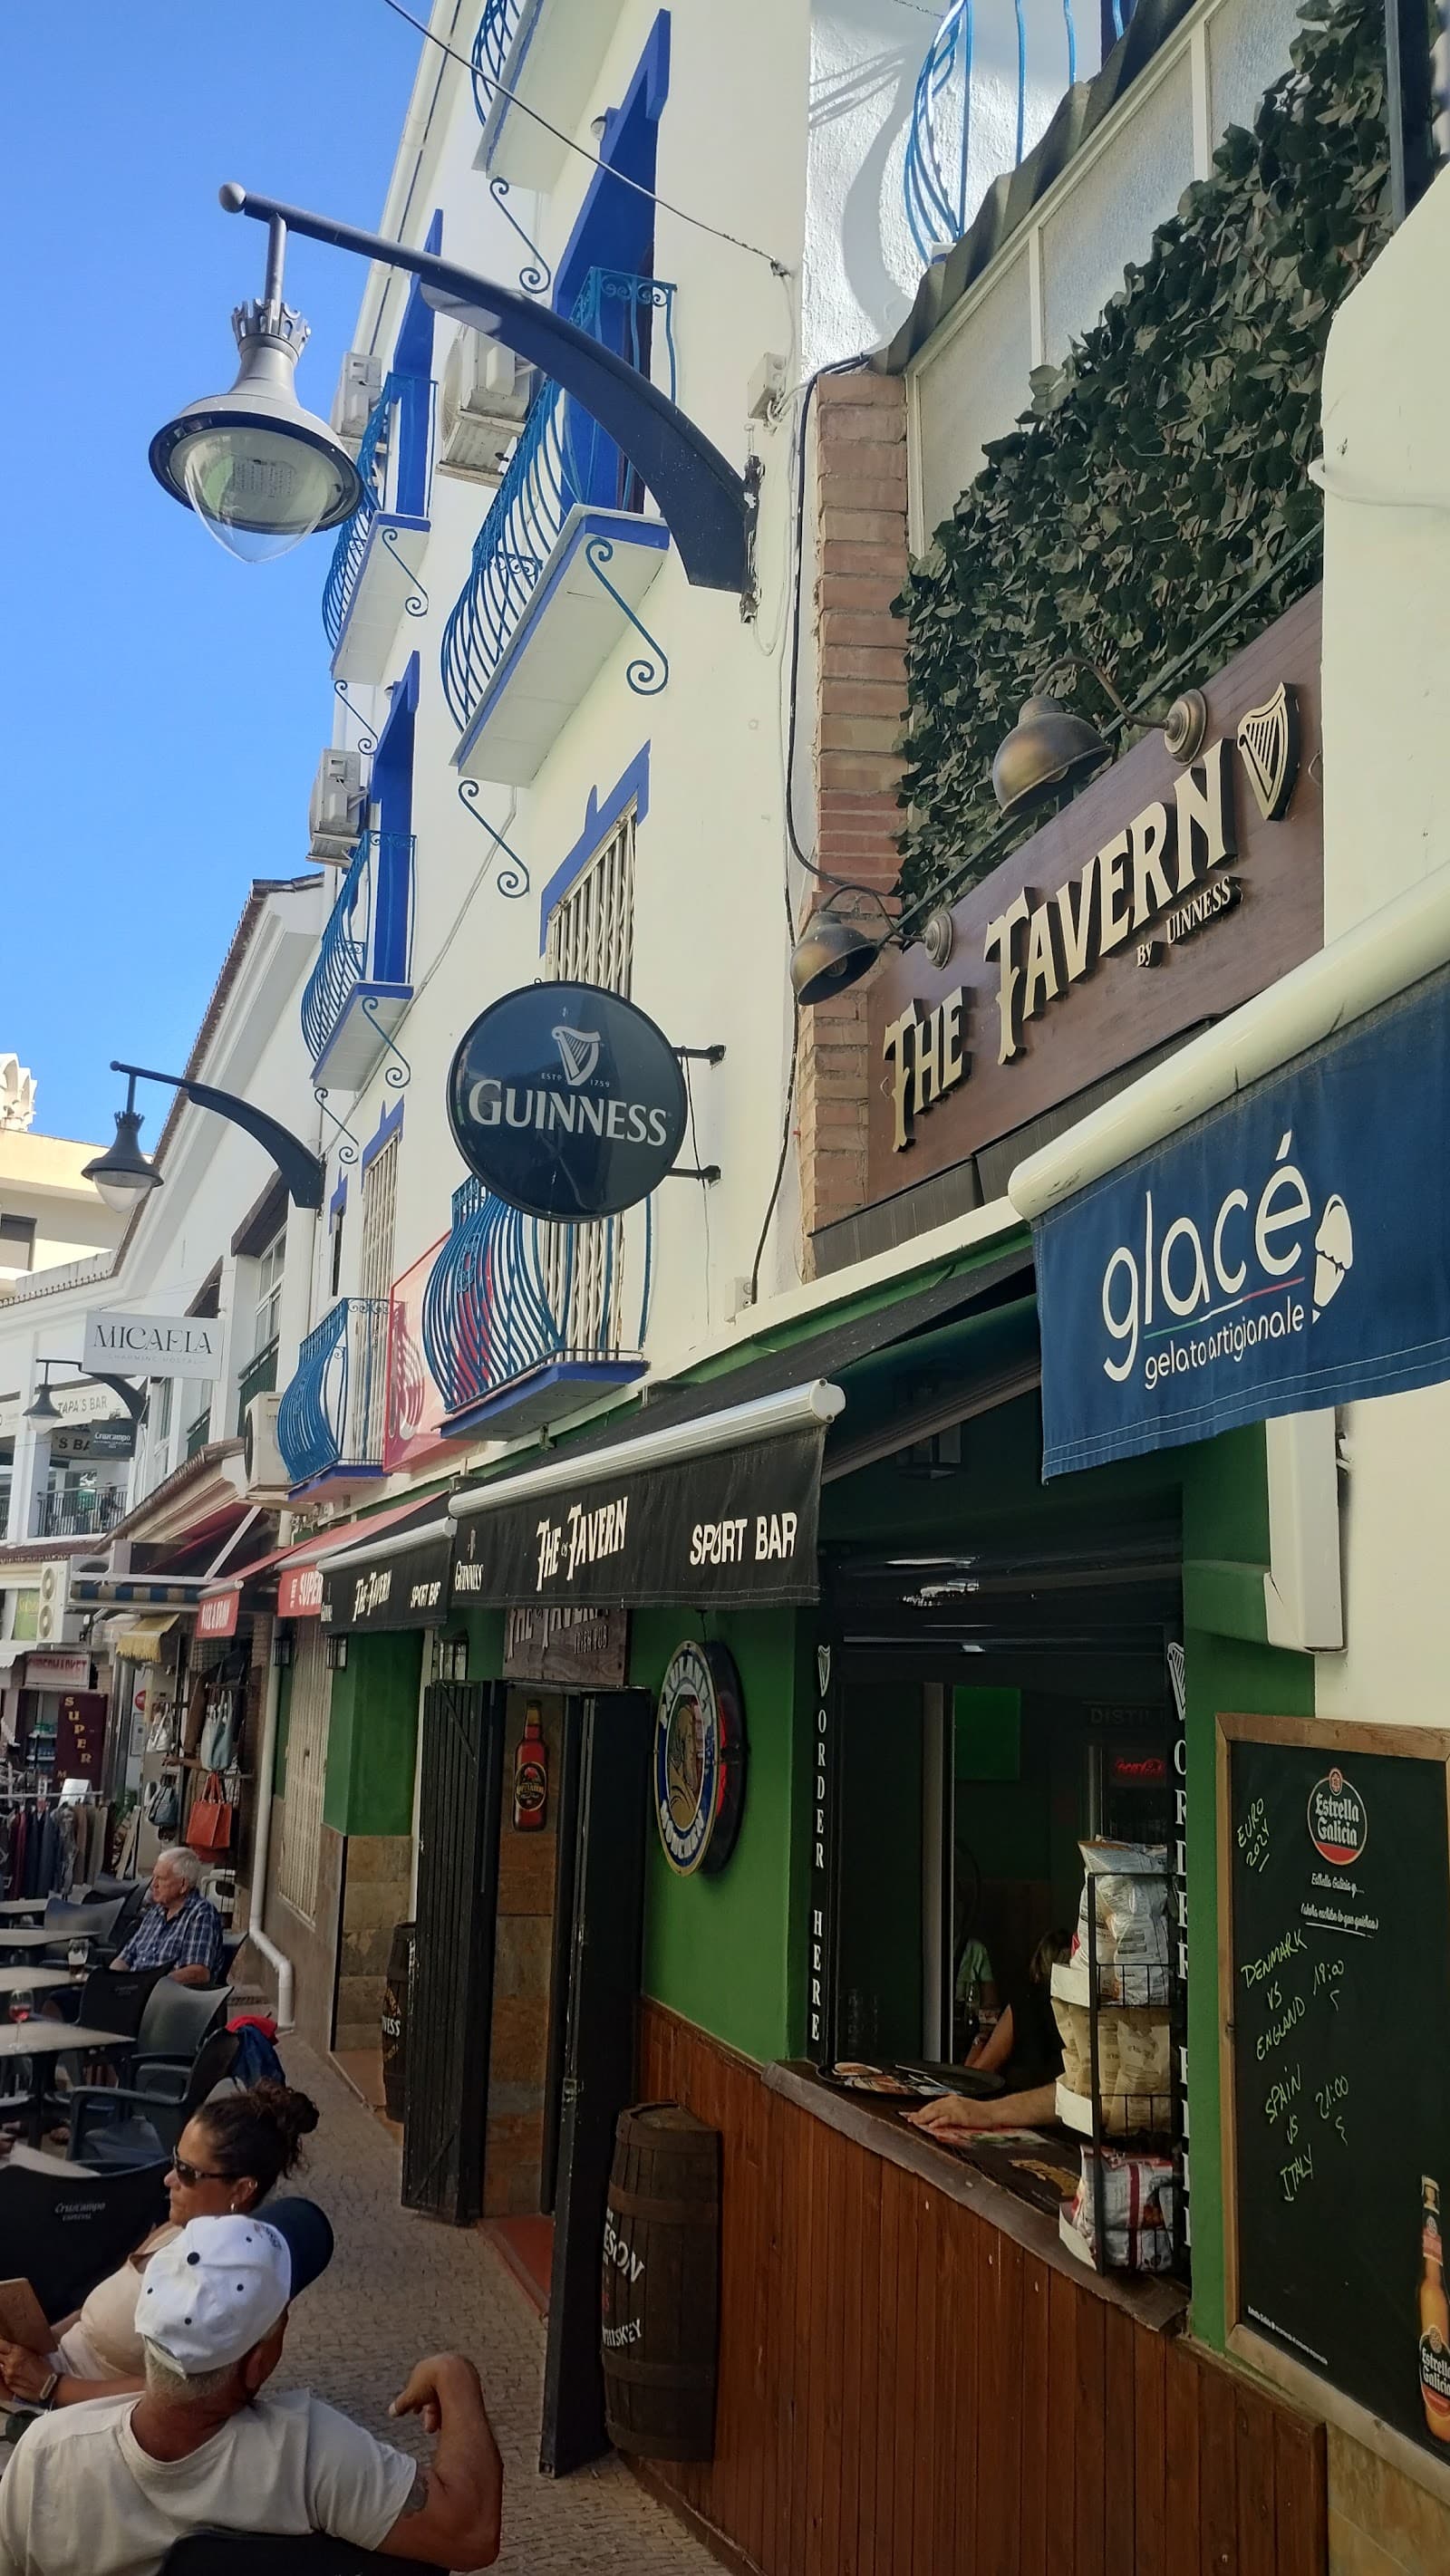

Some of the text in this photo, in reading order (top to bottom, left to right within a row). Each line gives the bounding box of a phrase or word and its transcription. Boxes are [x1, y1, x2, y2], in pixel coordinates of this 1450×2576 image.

[882, 738, 1231, 1154] THE TAVERN
[468, 1078, 668, 1146] GUINNESS
[589, 1079, 610, 1088] 1759
[1101, 1129, 1311, 1383] glacé
[93, 1324, 214, 1355] MICAELA
[90, 1395, 108, 1411] BAR
[536, 1496, 628, 1592] THE TAVERN
[690, 1511, 798, 1566] SPORT BAR
[64, 1695, 92, 1763] SUPER
[1237, 1798, 1264, 1848] EURO
[1315, 1791, 1360, 1824] Estrella
[1317, 1816, 1358, 1847] Galicia
[810, 1708, 828, 2041] ORDER HERE
[1241, 1927, 1309, 1989] DENMARK
[1255, 1995, 1306, 2061] ENGLAND
[1265, 2063, 1303, 2124] SPAIN
[1280, 2143, 1313, 2202] ITALY
